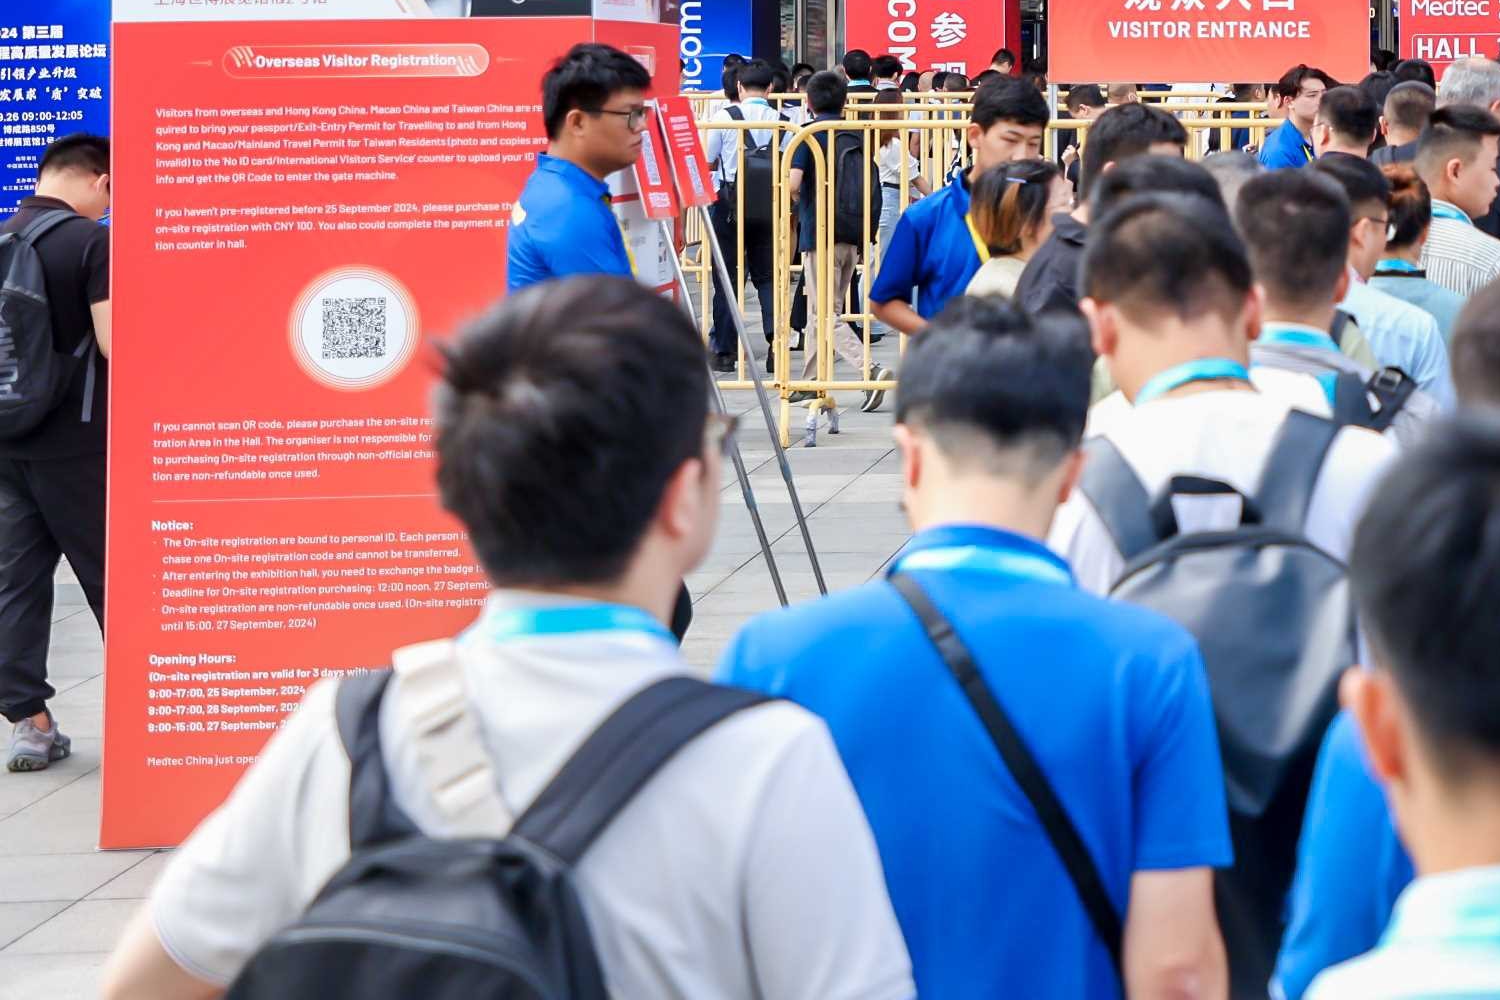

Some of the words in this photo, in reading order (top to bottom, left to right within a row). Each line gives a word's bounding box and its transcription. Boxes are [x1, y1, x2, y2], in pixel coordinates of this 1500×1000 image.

[0, 27, 17, 39] 24
[1108, 20, 1191, 39] VISITOR
[1197, 20, 1311, 39] ENTRANCE
[1417, 37, 1485, 59] HALL
[255, 55, 320, 68] Overseas
[323, 54, 368, 67] Visitor
[371, 53, 456, 68] Registration
[152, 519, 193, 531] Notice:
[149, 653, 196, 667] Opening
[199, 653, 236, 664] Hours:
[281, 702, 300, 714] 202
